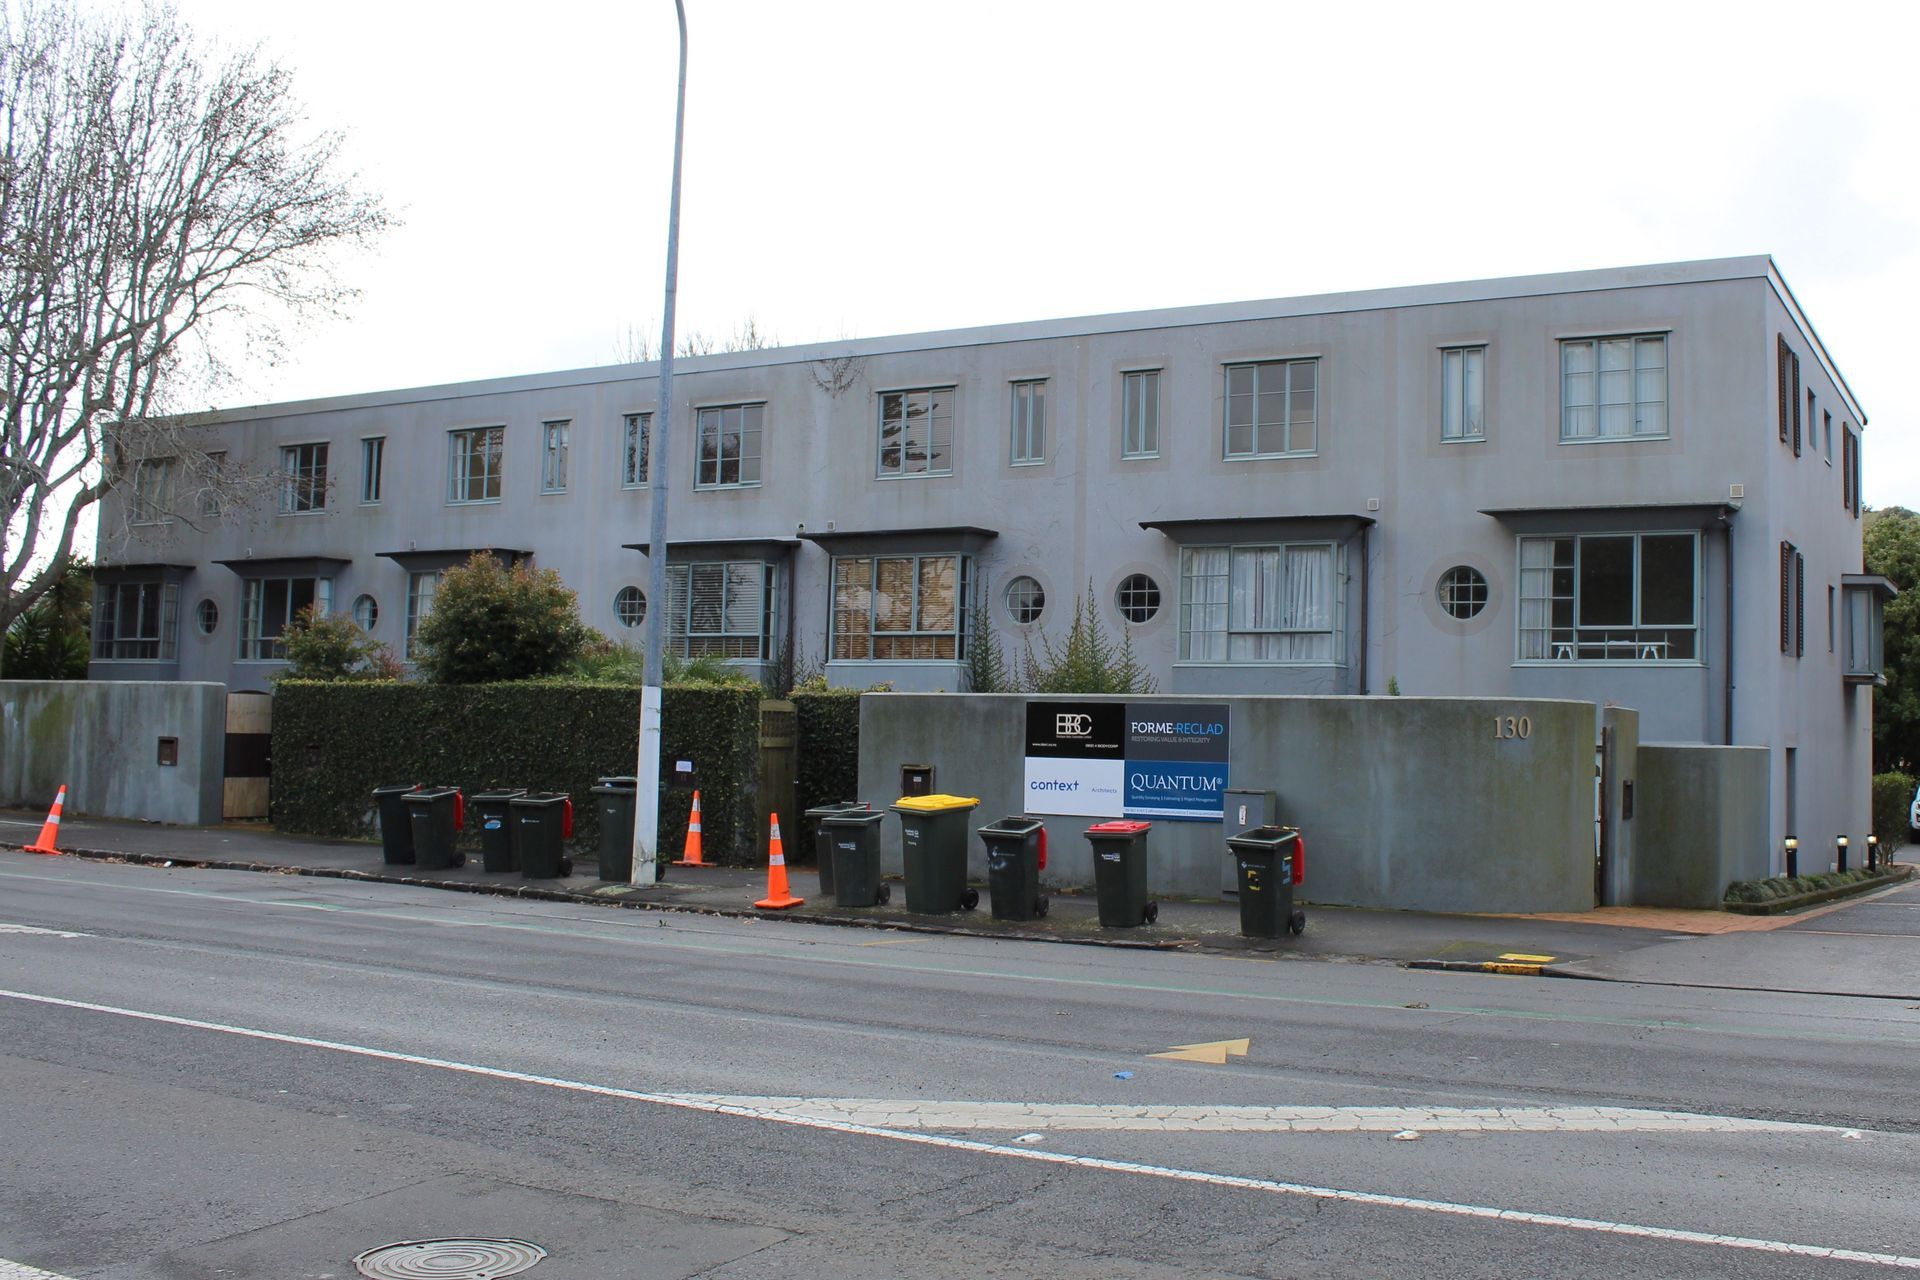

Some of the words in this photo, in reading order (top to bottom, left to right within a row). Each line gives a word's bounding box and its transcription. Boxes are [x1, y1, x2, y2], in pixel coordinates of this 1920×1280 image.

[1131, 722, 1224, 735] FORME-RECLAD
[1493, 716, 1533, 739] 130
[1030, 779, 1080, 791] context
